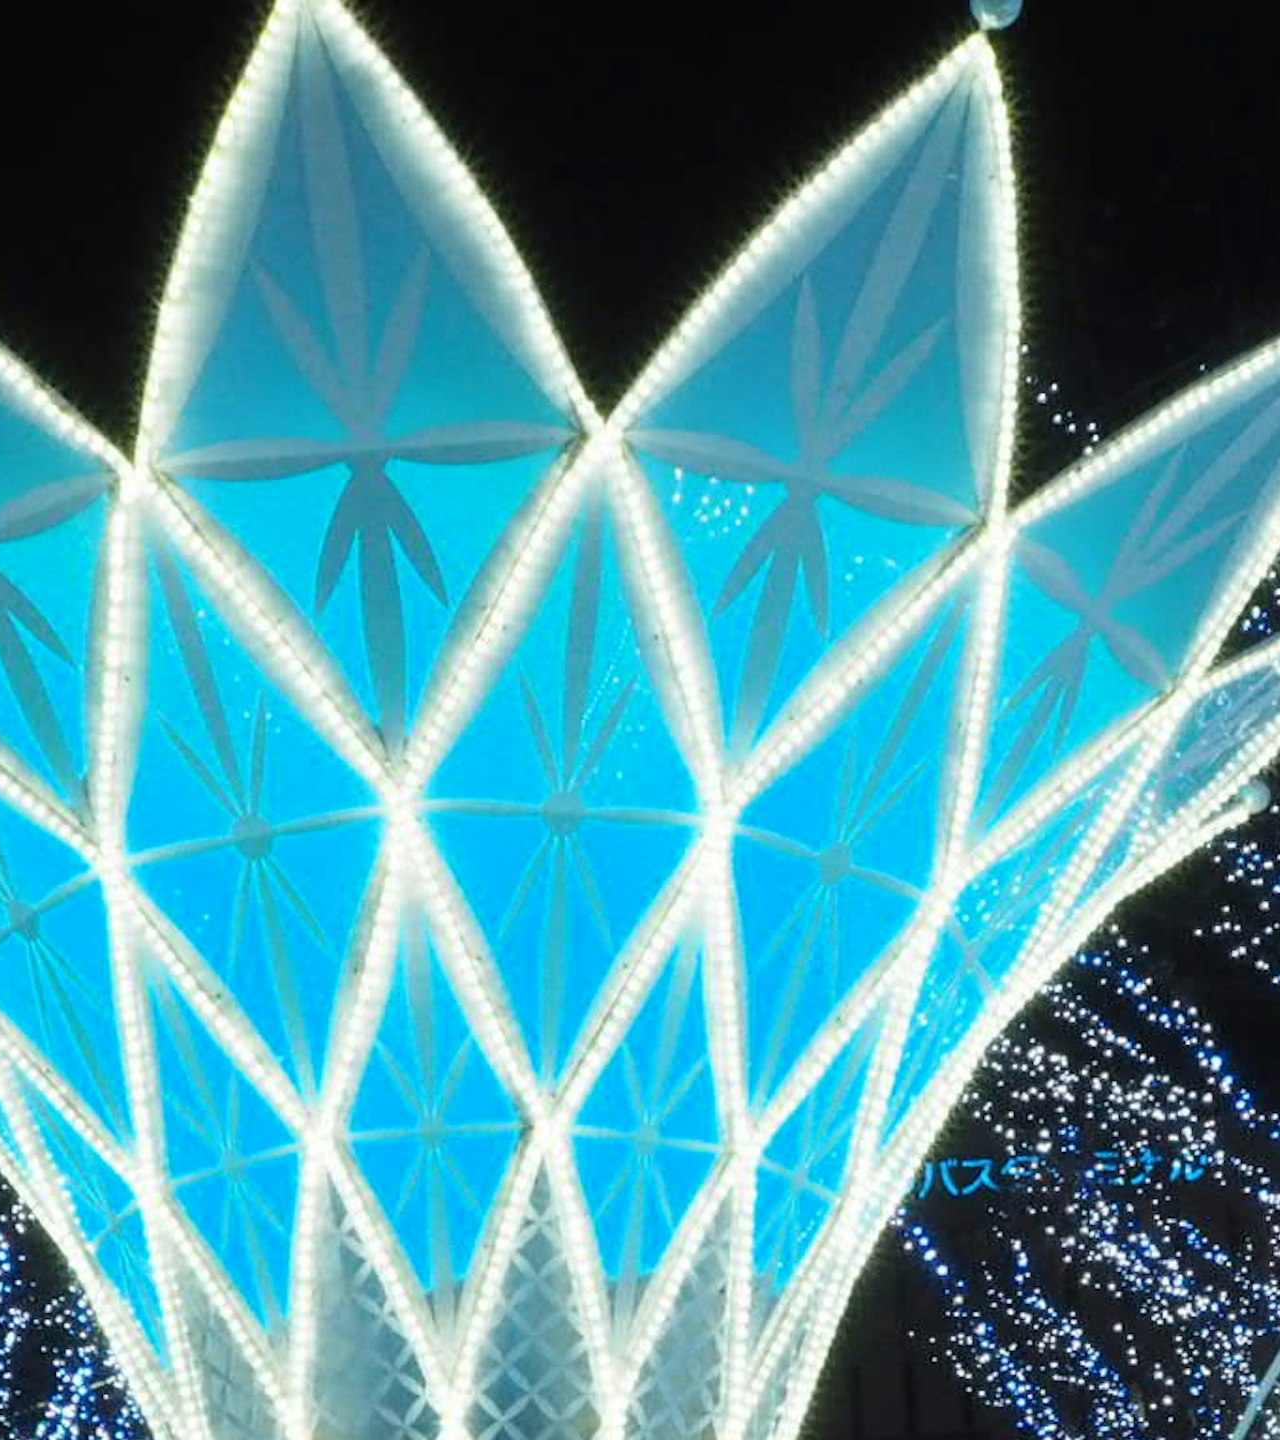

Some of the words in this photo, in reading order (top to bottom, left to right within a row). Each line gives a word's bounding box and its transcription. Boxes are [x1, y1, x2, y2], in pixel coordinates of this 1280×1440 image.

[917, 1147, 1209, 1198] バスタミナル
